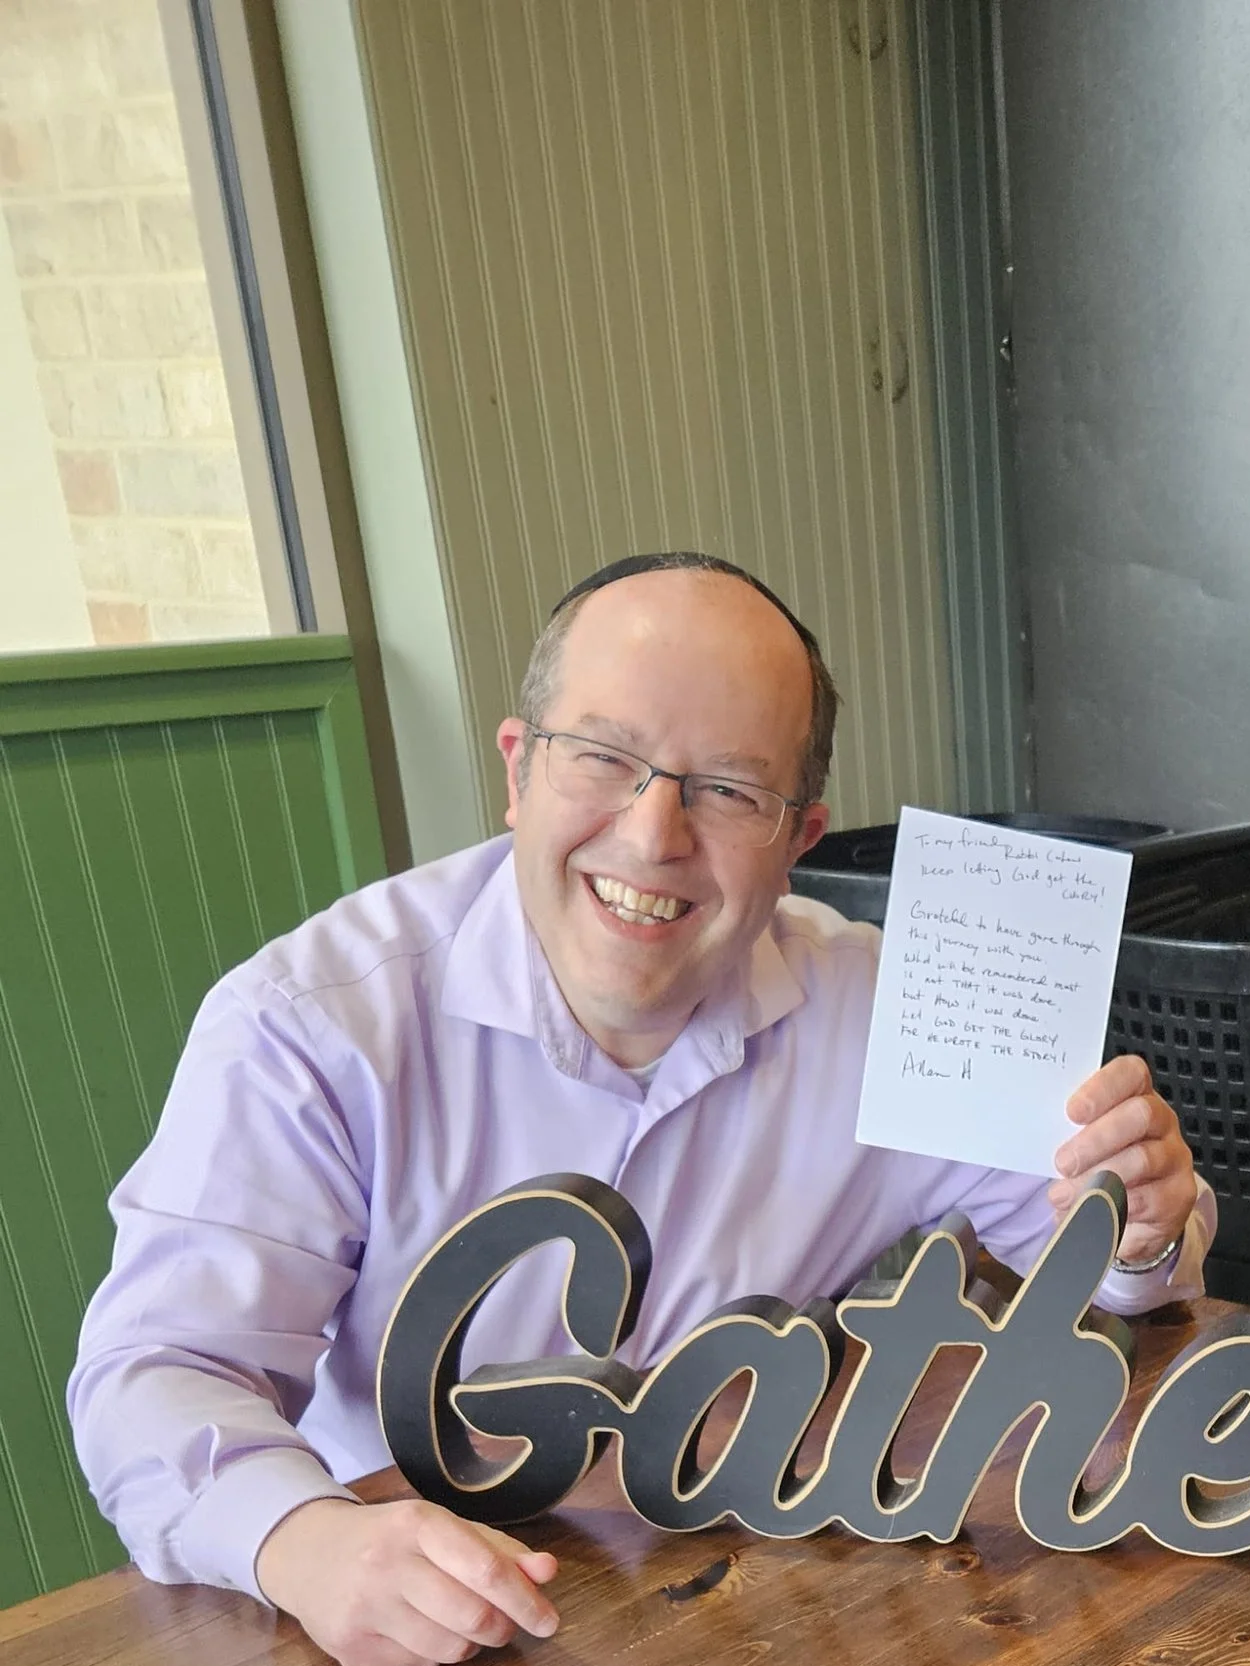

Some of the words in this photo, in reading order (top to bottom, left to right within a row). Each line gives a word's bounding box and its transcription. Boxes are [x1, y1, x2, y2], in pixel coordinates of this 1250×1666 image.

[935, 838, 953, 850] my
[1012, 866, 1040, 882] God
[1046, 873, 1066, 889] get
[1075, 872, 1098, 886] the
[910, 900, 968, 928] Grateful
[975, 915, 988, 930] to
[996, 918, 1023, 939] have
[1062, 933, 1101, 955] through
[908, 926, 928, 941] this
[934, 933, 979, 956] journey
[987, 945, 1015, 957] with
[904, 952, 930, 965] What
[961, 961, 976, 976] be
[982, 967, 1049, 986] remembered
[1054, 980, 1082, 994] most
[925, 974, 944, 986] not
[952, 979, 982, 994] THAT
[986, 983, 998, 995] it
[1003, 990, 1023, 1001] was
[902, 987, 925, 1001] but
[967, 1000, 976, 1011] it
[984, 1006, 1003, 1017] was
[944, 1035, 981, 1050] WROTE
[991, 1044, 1015, 1057] THE
[963, 1021, 986, 1034] GET
[992, 1024, 1013, 1038] THE
[1020, 1029, 1060, 1048] GLORY
[961, 1057, 973, 1081] H
